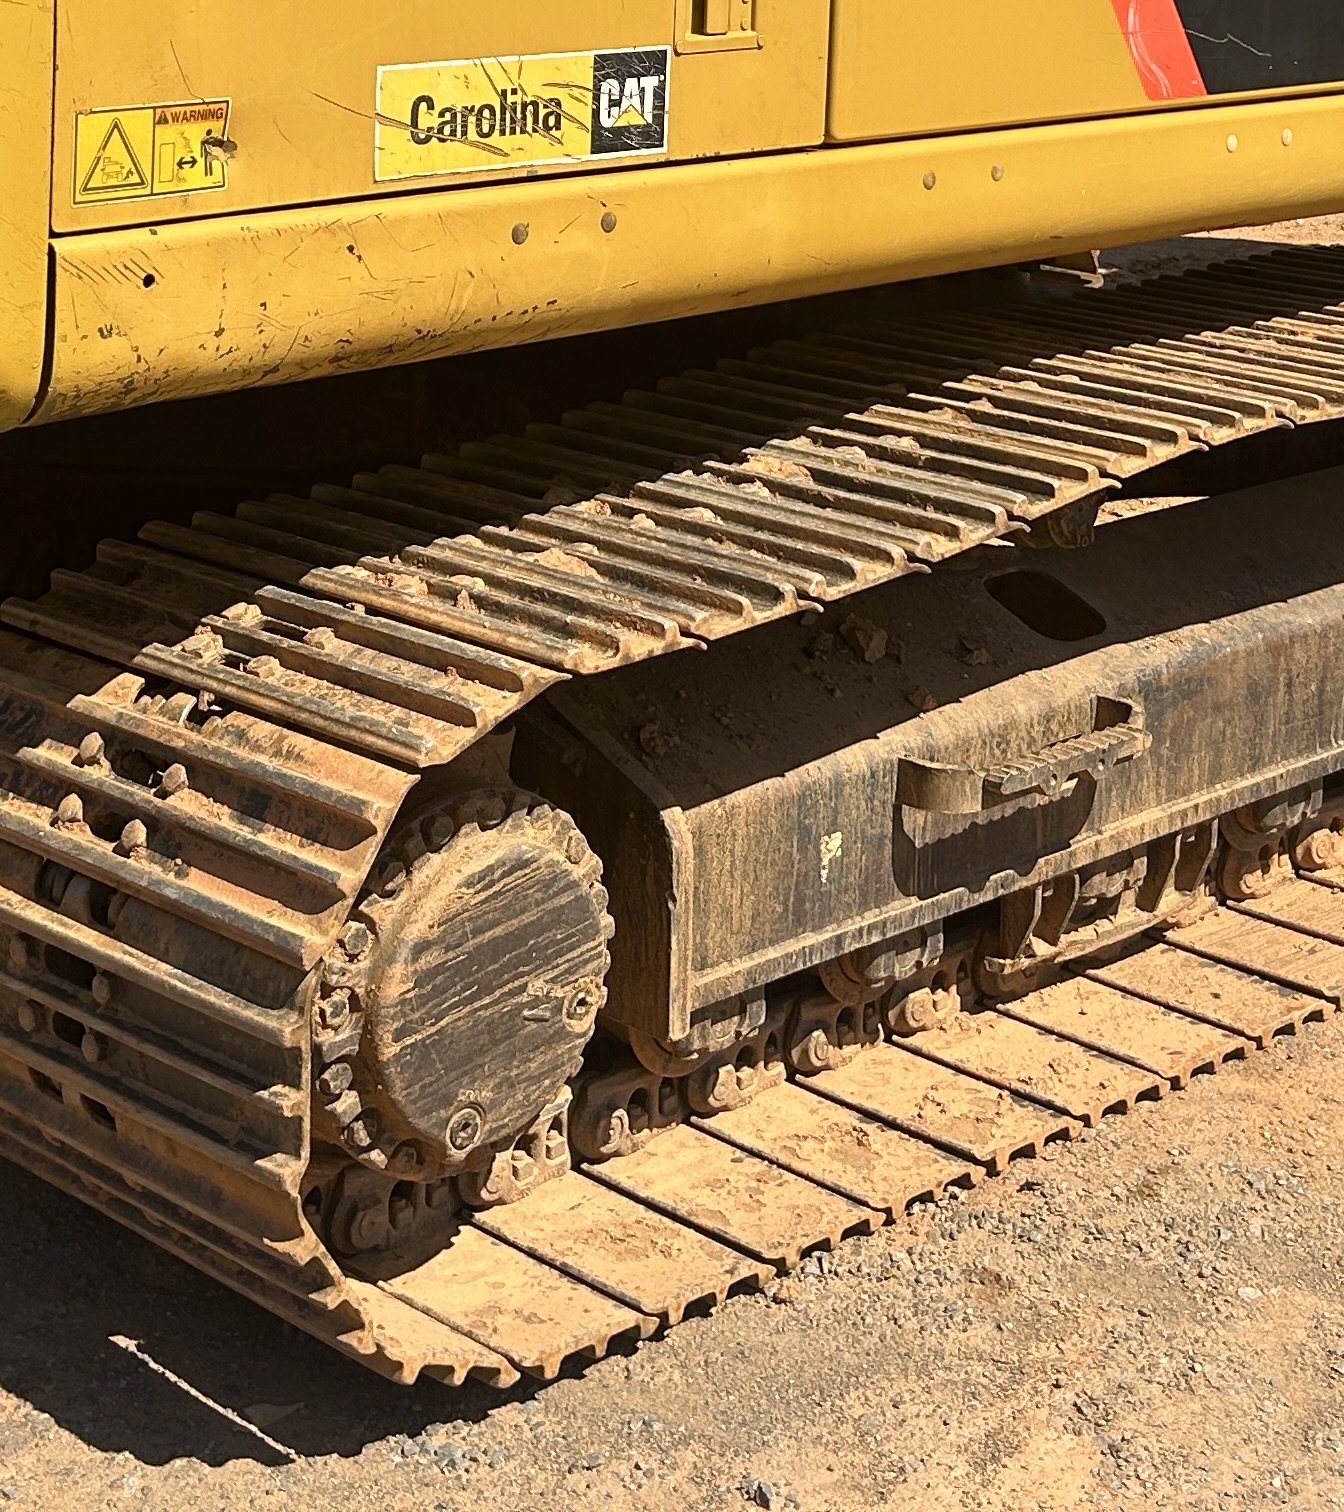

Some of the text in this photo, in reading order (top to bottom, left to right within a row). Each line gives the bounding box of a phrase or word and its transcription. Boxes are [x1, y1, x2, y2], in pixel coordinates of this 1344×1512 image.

[170, 107, 224, 124] WARNING
[410, 75, 659, 145] Carolina CAT
